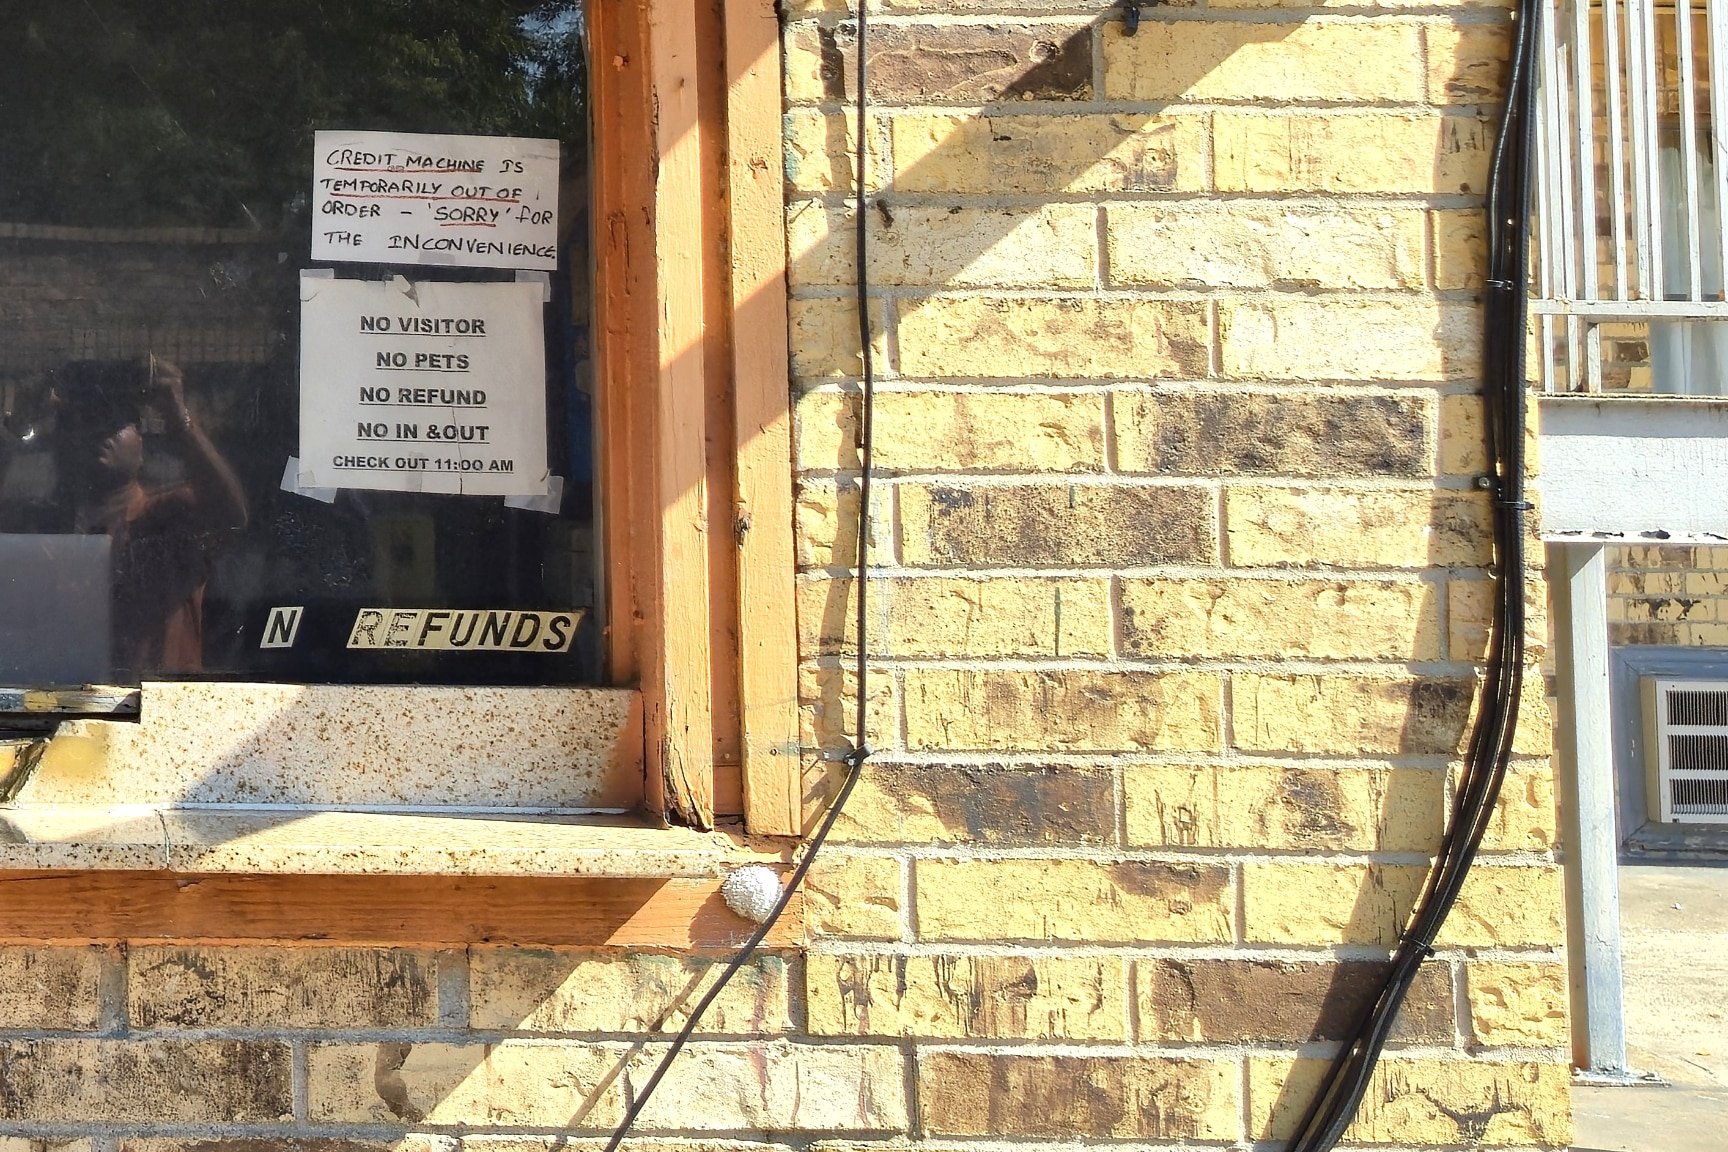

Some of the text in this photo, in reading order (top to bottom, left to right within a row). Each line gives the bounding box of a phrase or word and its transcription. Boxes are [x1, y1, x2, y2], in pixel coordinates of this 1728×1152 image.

[326, 149, 398, 167] CREDIT
[406, 155, 485, 172] MACHINE
[499, 159, 524, 174] IS
[320, 178, 523, 199] TEMPORARILY OUT OF
[321, 200, 381, 217] ORDER
[324, 230, 363, 247] THE
[360, 315, 486, 334] NO VISITOR
[376, 351, 470, 369] NO PETS
[360, 386, 487, 405] NO REFUND
[357, 422, 388, 438] NO
[396, 424, 418, 439] IN
[333, 455, 514, 472] CHECK OUT 11:00 AM
[351, 609, 571, 651] REFUNDS
